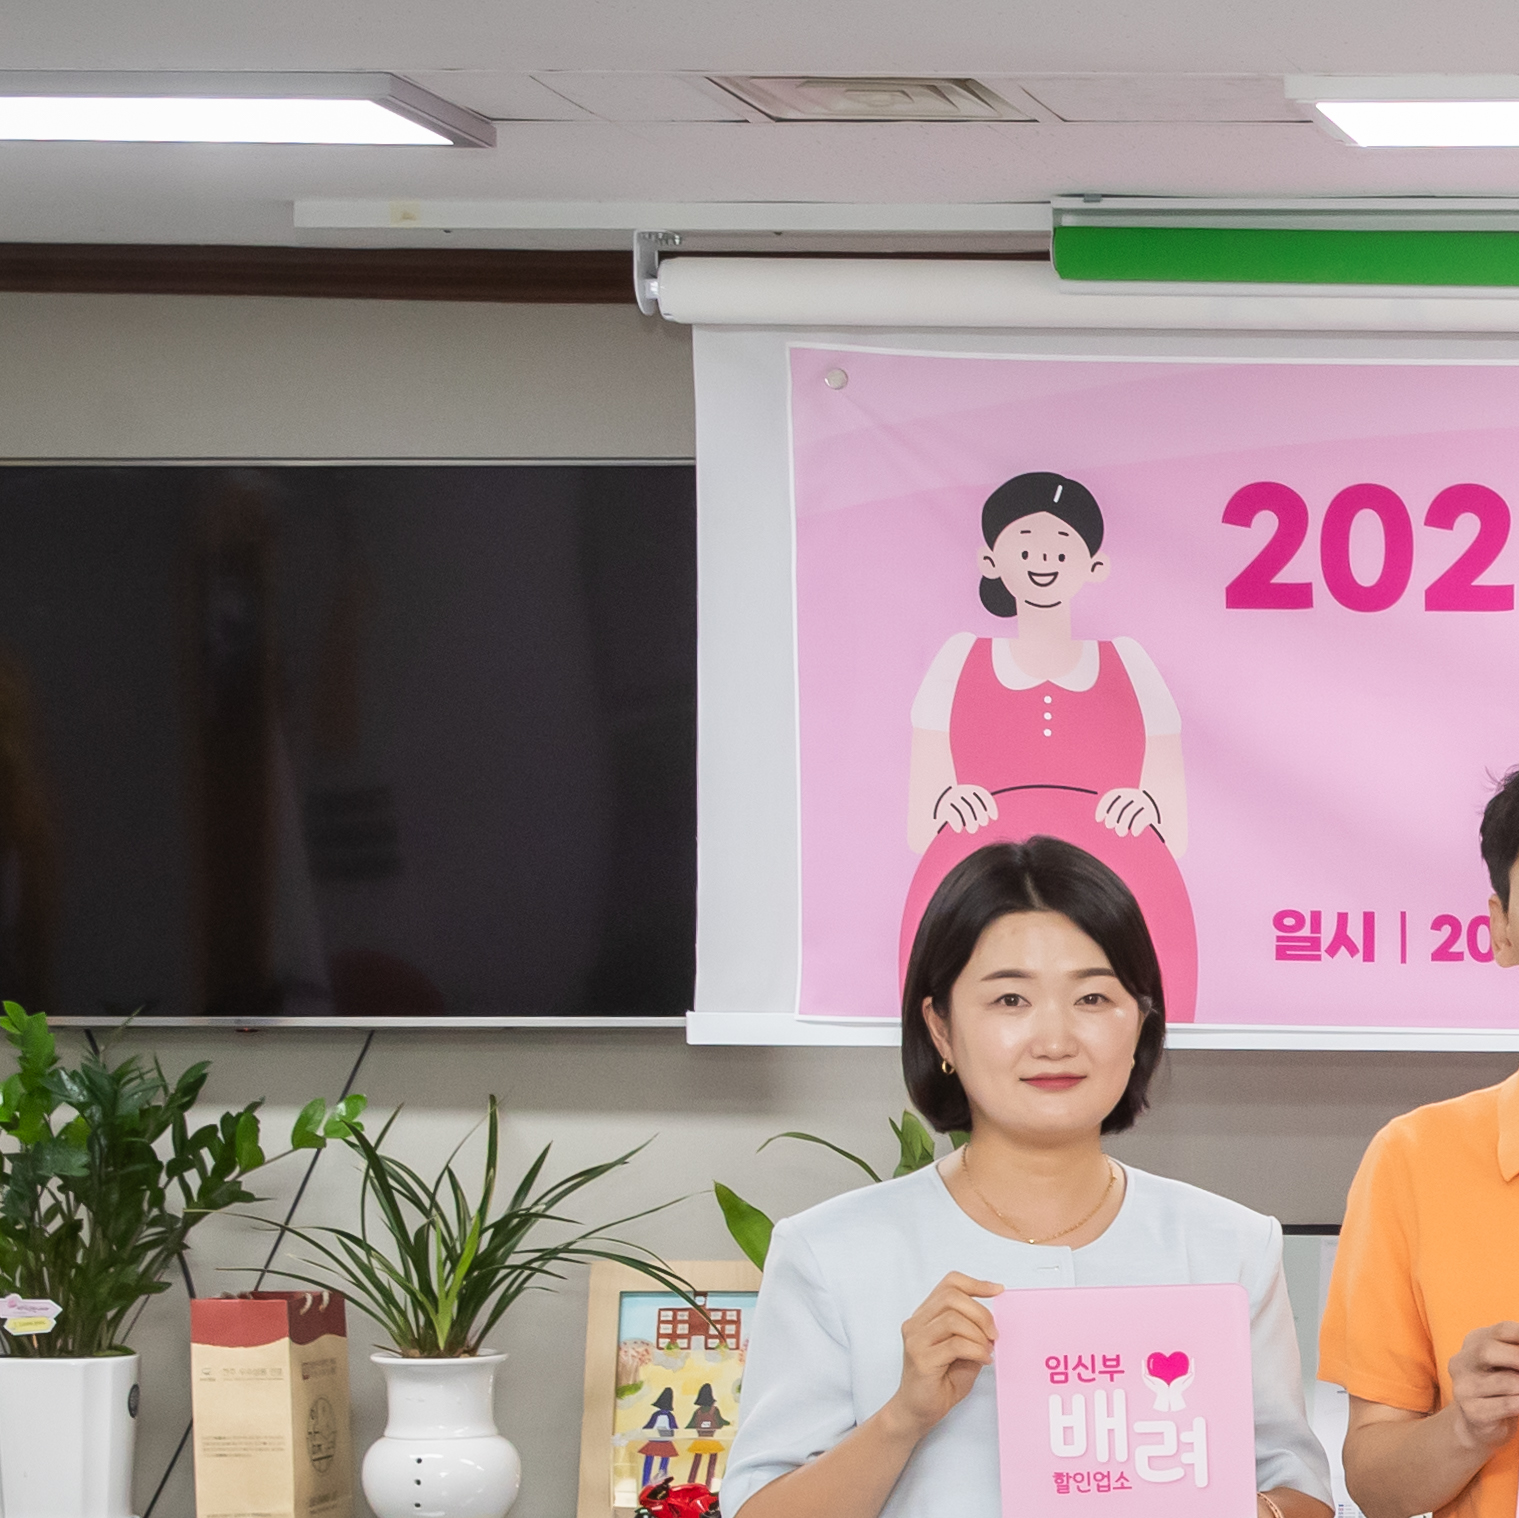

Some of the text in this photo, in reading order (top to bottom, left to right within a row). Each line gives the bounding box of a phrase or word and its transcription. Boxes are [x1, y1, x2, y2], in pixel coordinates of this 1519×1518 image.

[1272, 909, 1376, 963] 일시
[1044, 1353, 1126, 1385] 임신부
[1048, 1388, 1209, 1488] 배려
[1052, 1470, 1133, 1495] 할인업소
